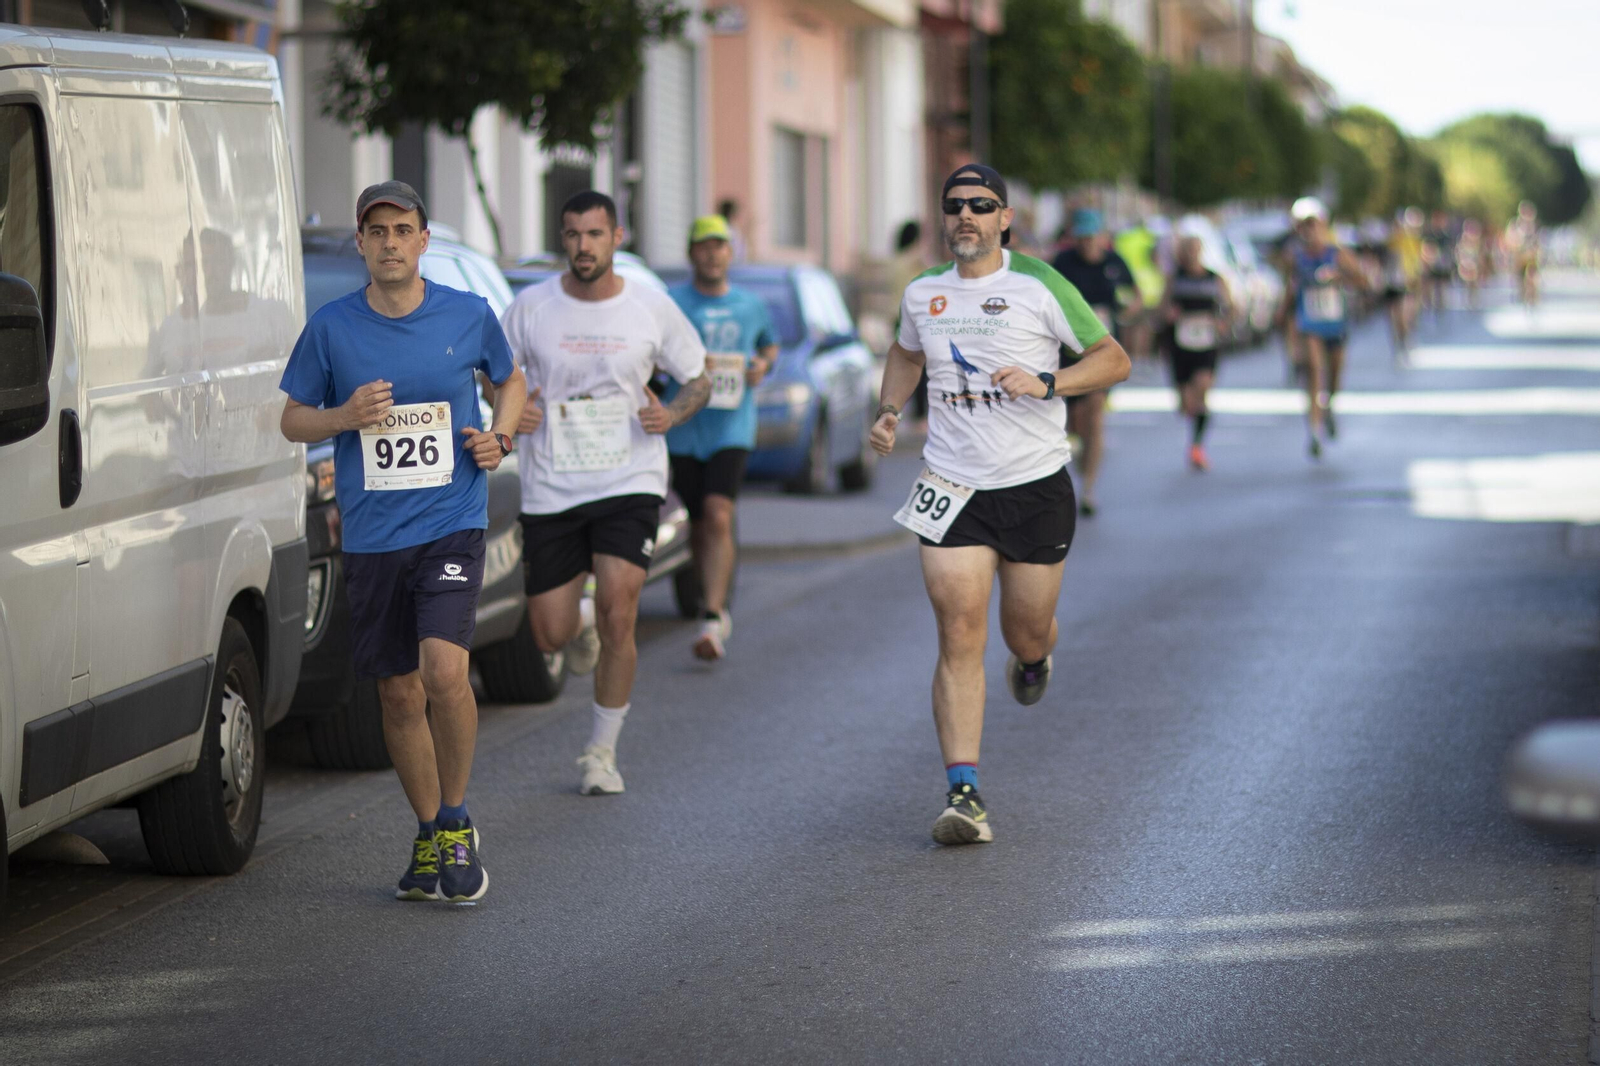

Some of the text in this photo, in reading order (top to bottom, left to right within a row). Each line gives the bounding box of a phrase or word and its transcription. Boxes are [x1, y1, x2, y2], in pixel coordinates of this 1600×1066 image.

[933, 318, 960, 326] CARRERA
[962, 317, 982, 326] BASE
[984, 317, 1010, 328] AÉREA
[375, 435, 440, 469] 926
[908, 482, 951, 521] 799
